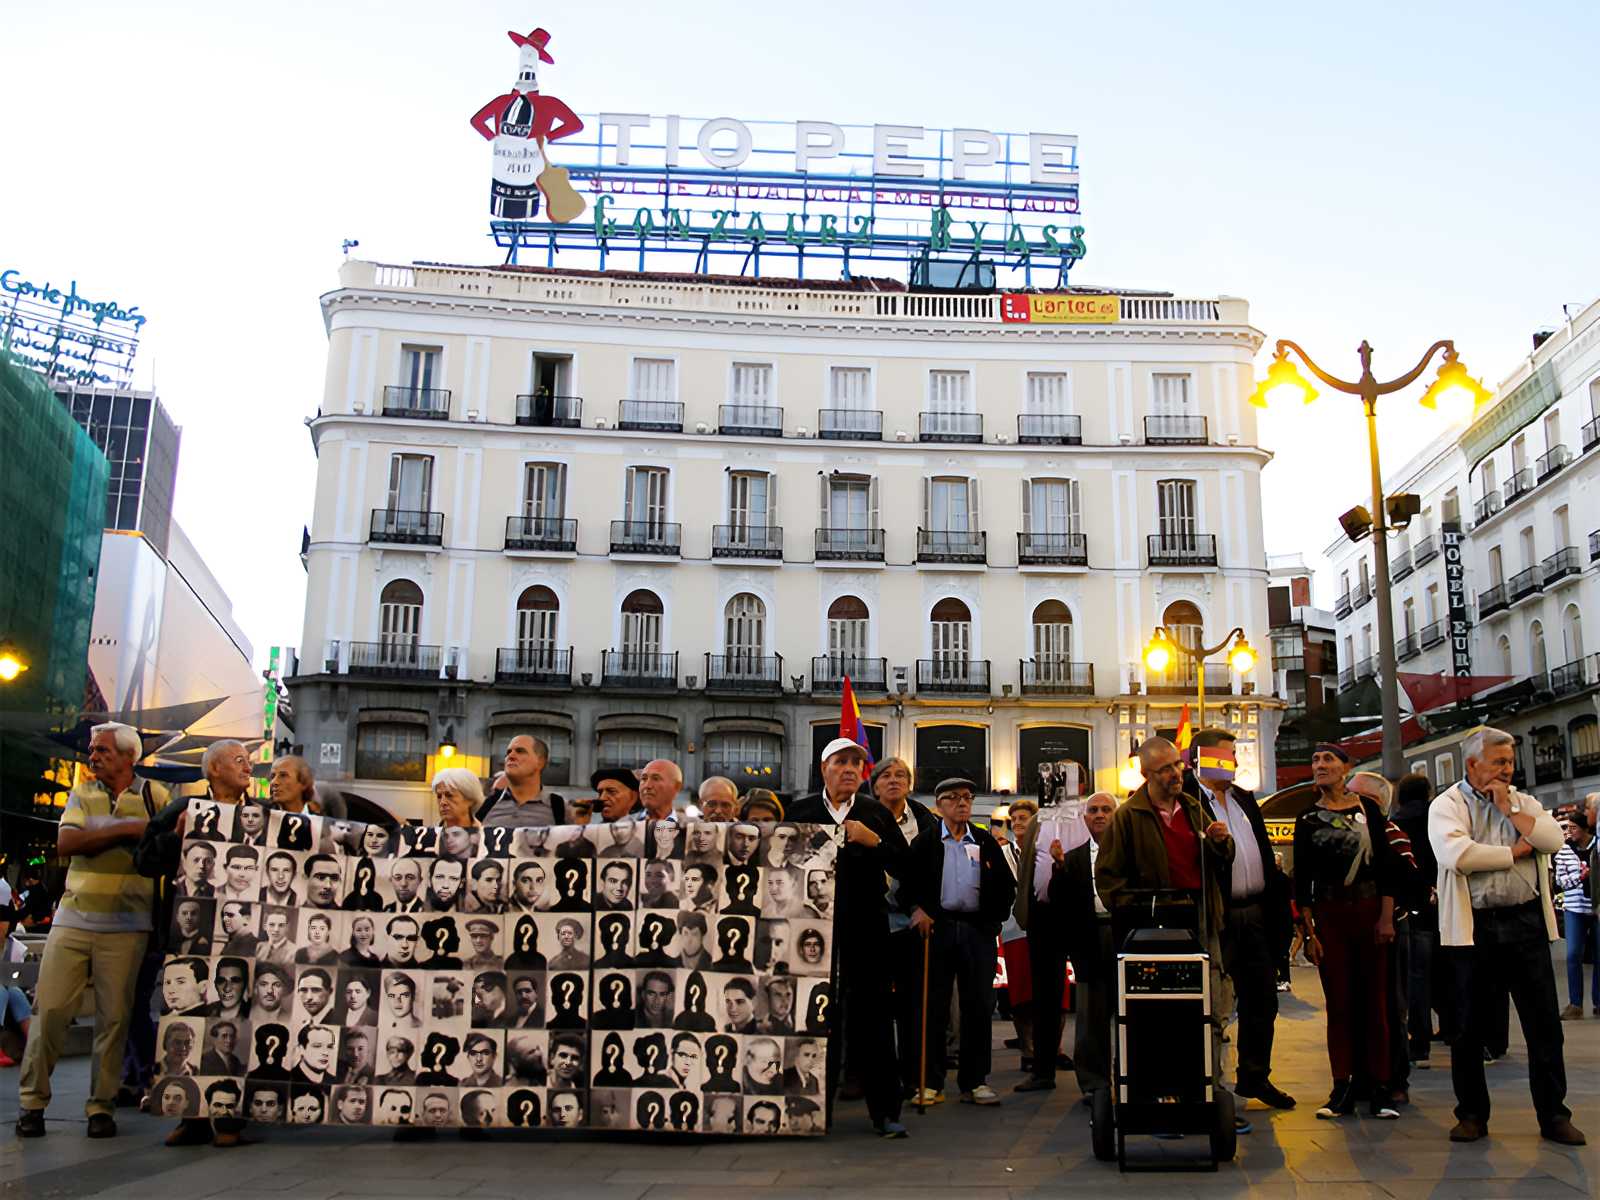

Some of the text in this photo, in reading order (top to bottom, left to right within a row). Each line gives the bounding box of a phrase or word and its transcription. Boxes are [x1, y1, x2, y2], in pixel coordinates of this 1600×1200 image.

[599, 112, 1080, 184] TIO PEPE
[594, 194, 1087, 257] GONZALEZ BYASS
[1, 269, 60, 304] Corte
[1443, 532, 1464, 608] HOTEL
[201, 810, 215, 833] ?
[288, 817, 302, 842] ?
[415, 827, 427, 850] ?
[493, 827, 505, 851] ?
[359, 867, 371, 896] ?
[565, 868, 579, 897] ?
[737, 873, 750, 900] ?
[436, 928, 449, 956] ?
[520, 924, 533, 952] ?
[610, 922, 623, 949] ?
[650, 921, 663, 949] ?
[727, 928, 740, 956] ?
[561, 981, 575, 1009] ?
[610, 980, 624, 1008] ?
[690, 985, 700, 1012] ?
[815, 995, 829, 1022] ?
[265, 1035, 280, 1065] ?
[432, 1044, 446, 1071] ?
[606, 1044, 620, 1073] ?
[647, 1045, 659, 1073] ?
[715, 1045, 728, 1073] ?
[520, 1099, 533, 1126] ?
[648, 1102, 660, 1129] ?
[680, 1100, 692, 1129] ?
